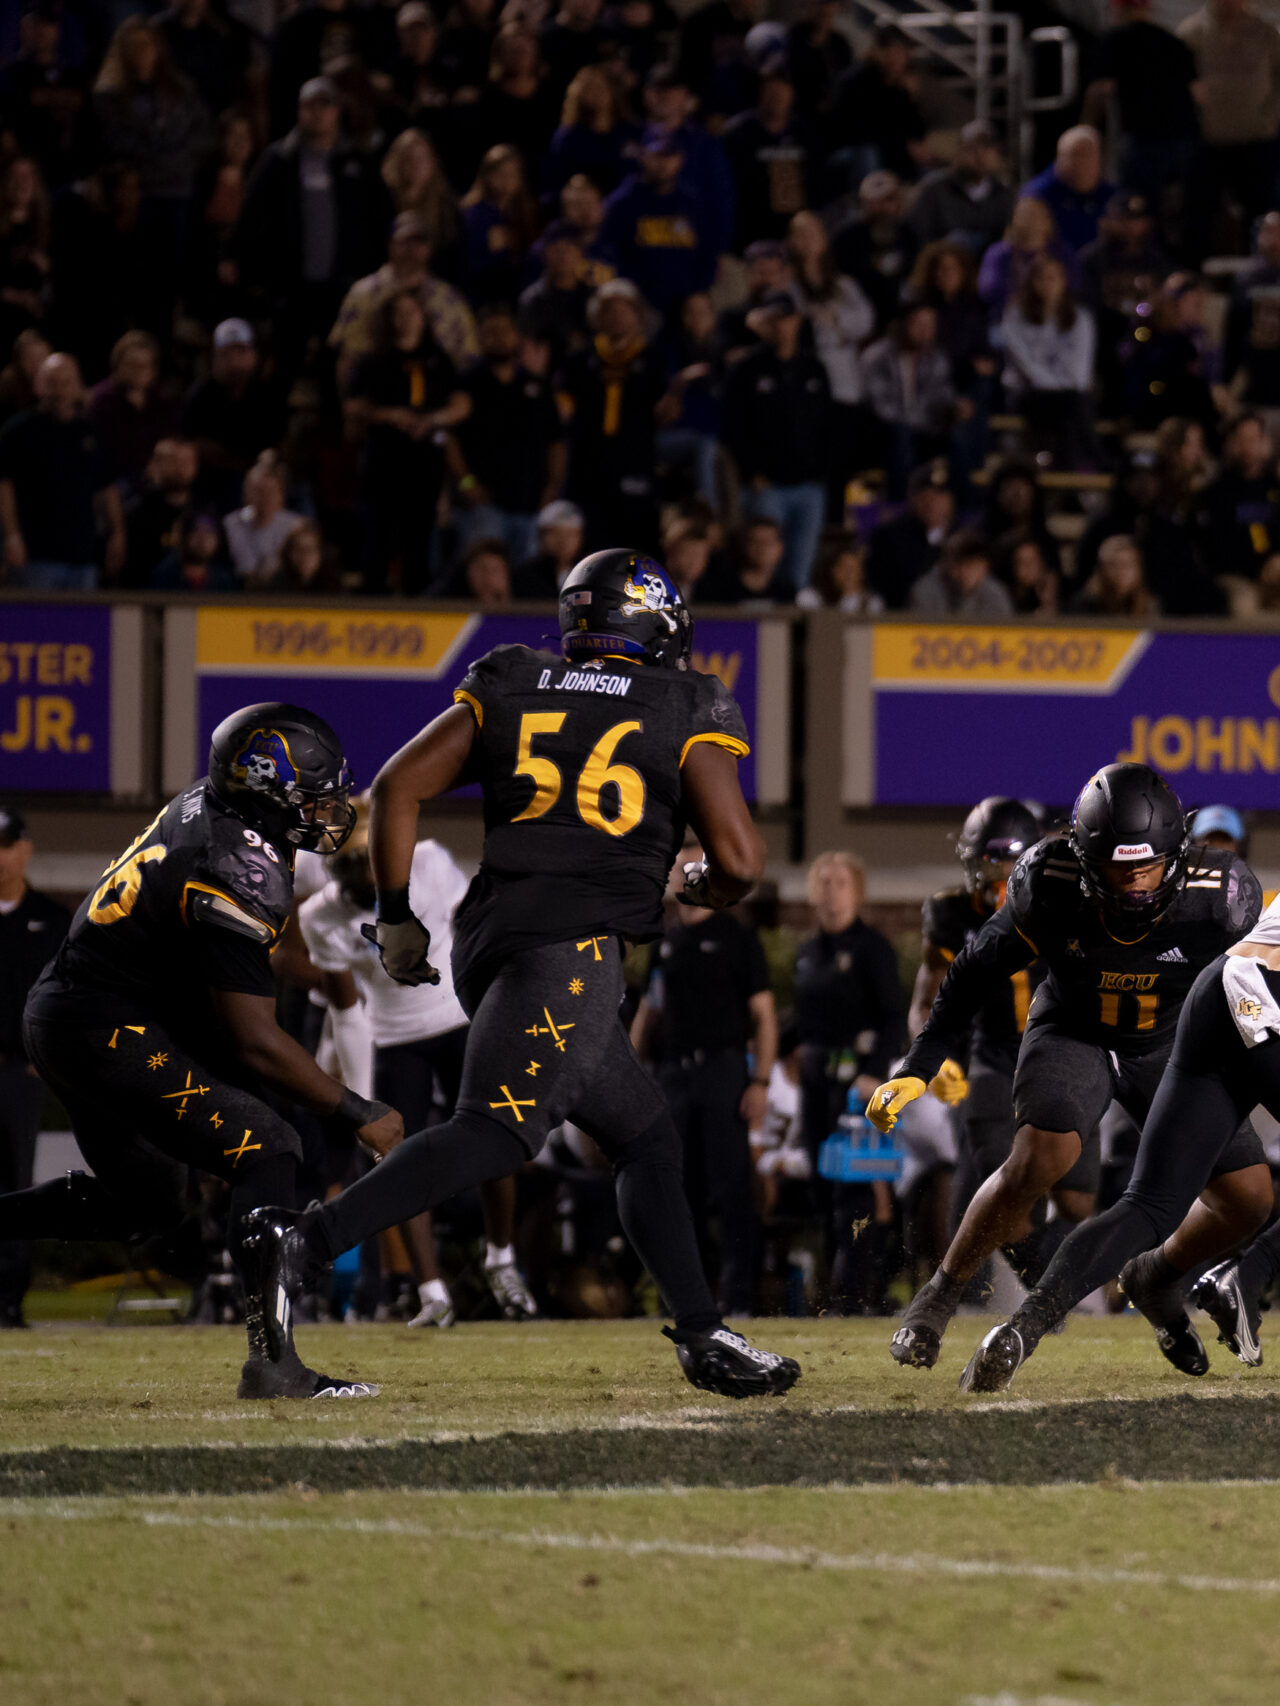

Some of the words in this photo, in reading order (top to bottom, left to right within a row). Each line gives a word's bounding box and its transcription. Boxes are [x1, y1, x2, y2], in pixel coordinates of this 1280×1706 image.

[253, 620, 423, 657] 1996-1999
[912, 637, 1103, 671] 2004-2007
[537, 669, 551, 690] D.
[554, 671, 632, 697] JOHNSON
[1, 694, 91, 752] JR.
[510, 711, 648, 837] 56
[242, 829, 279, 863] 96
[1118, 847, 1149, 856] Riddell
[1156, 954, 1188, 963] adidas
[1098, 971, 1160, 991] ECU
[1098, 993, 1160, 1030] 11
